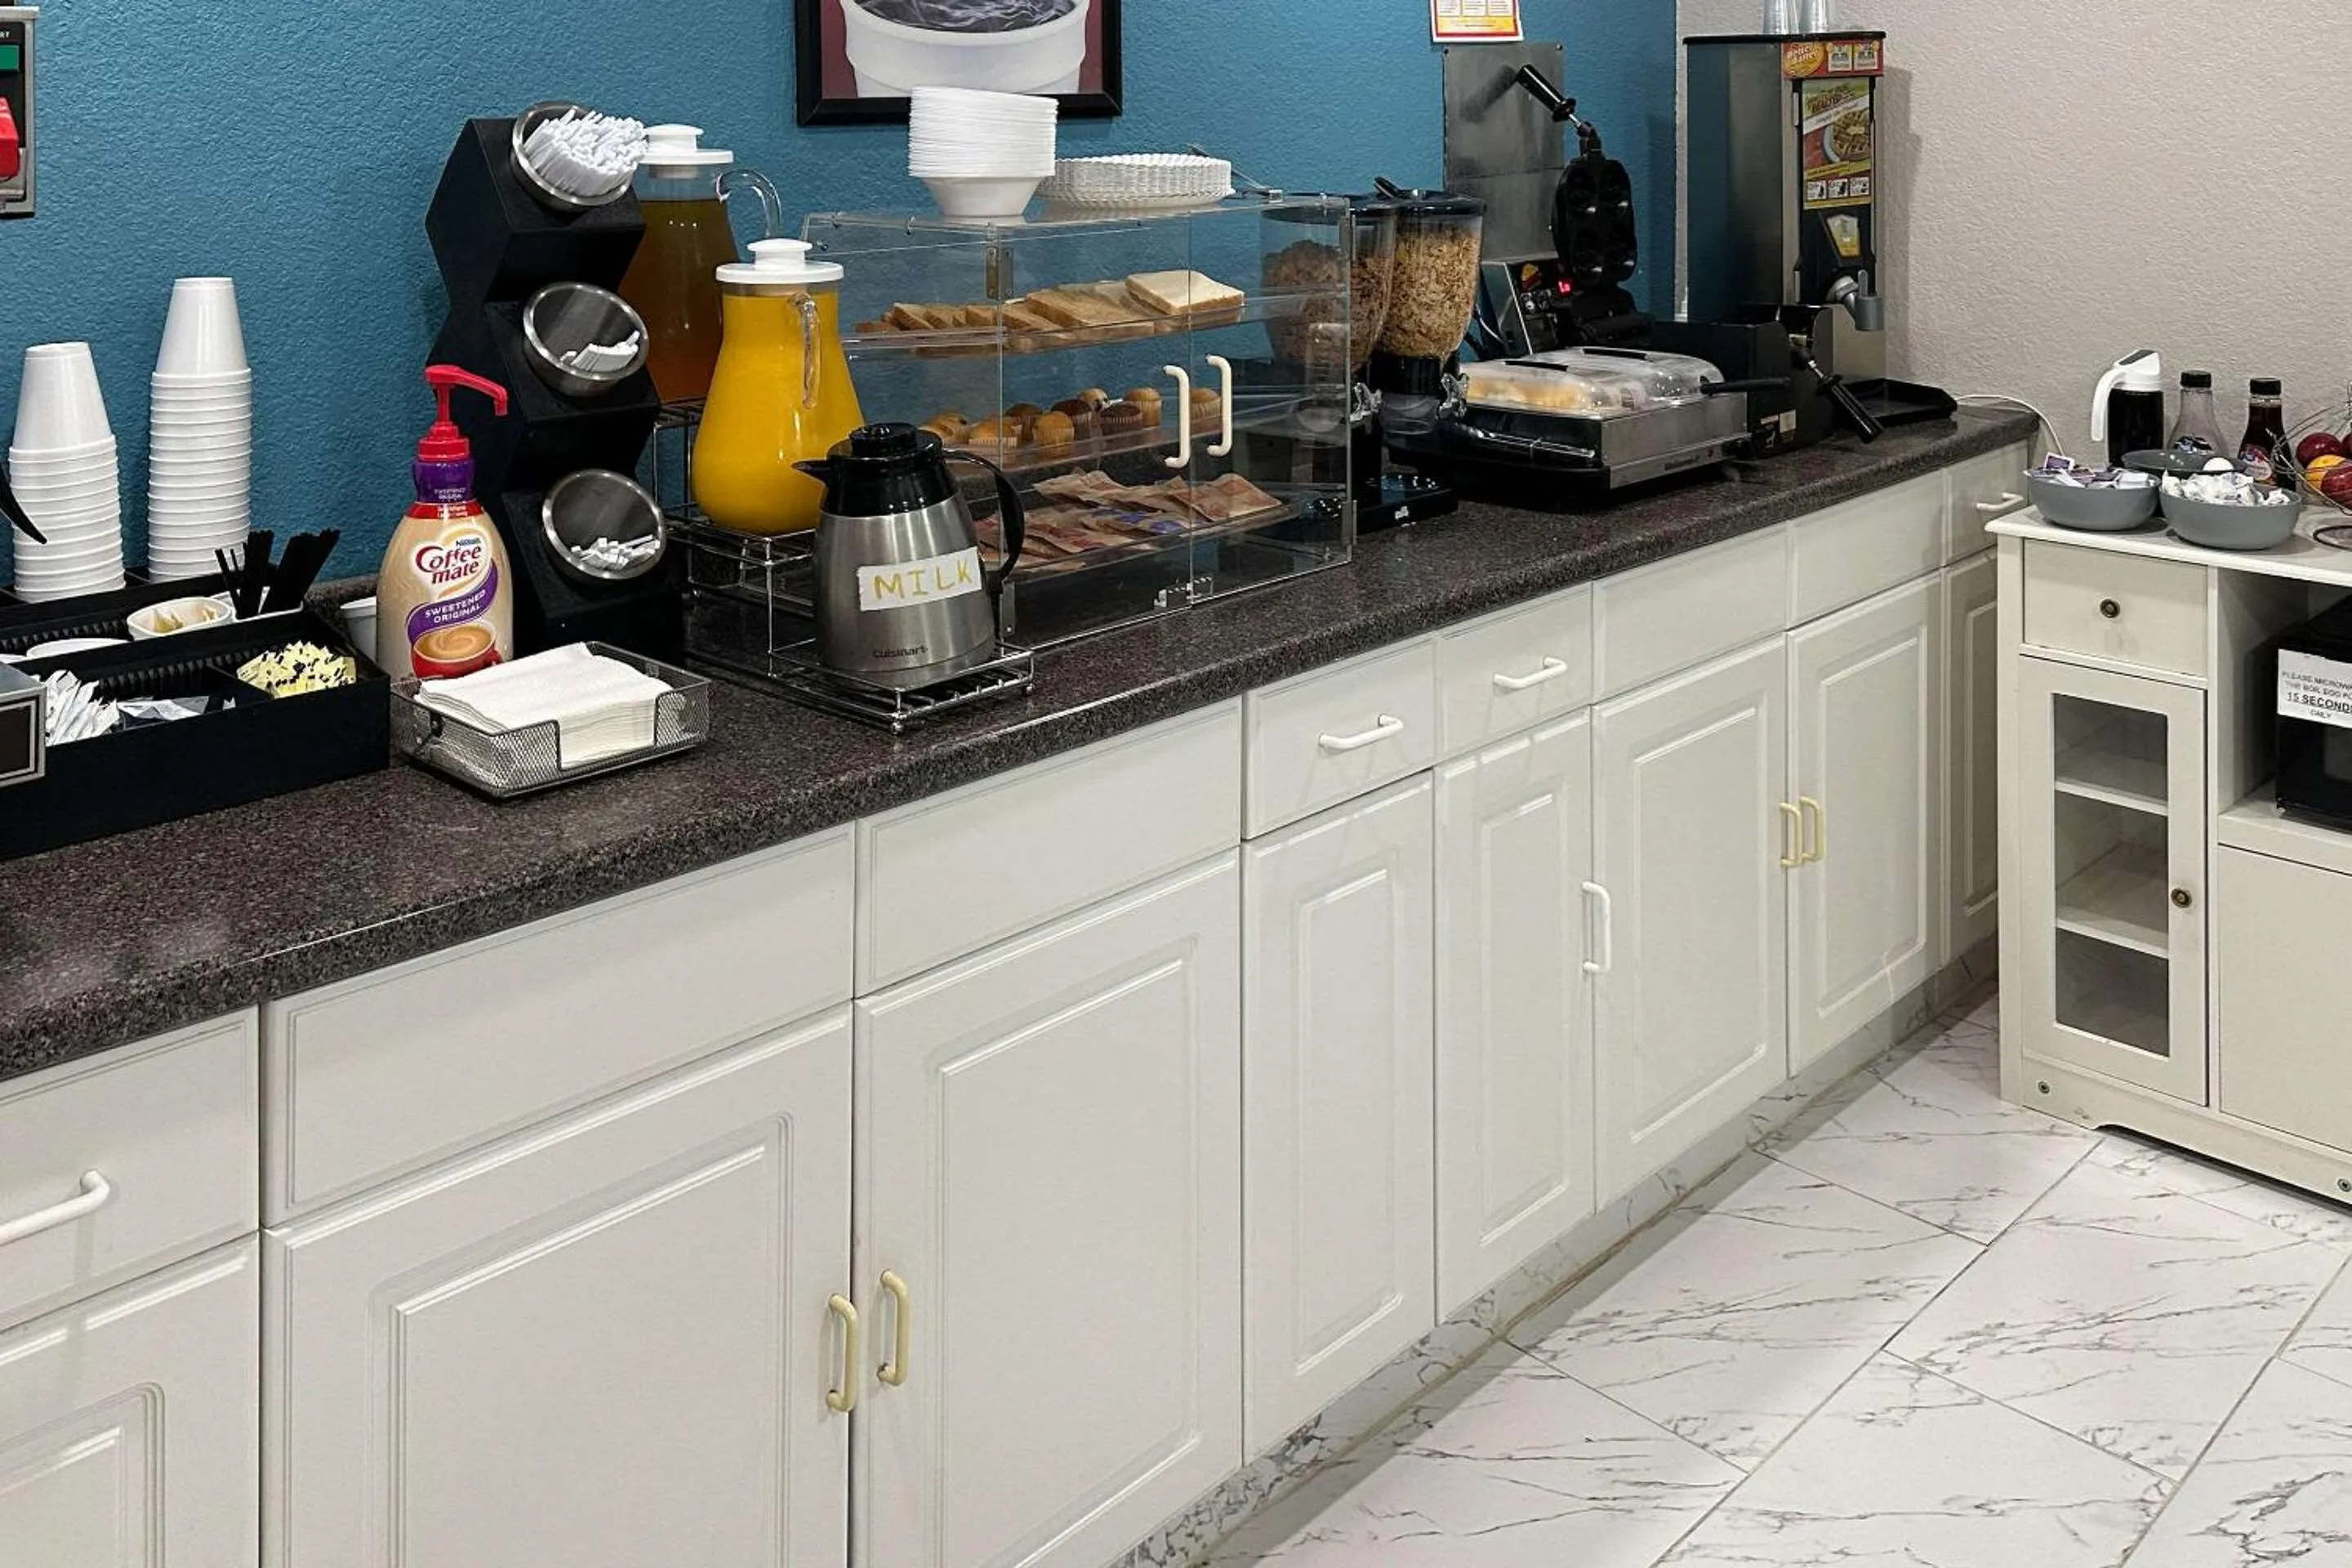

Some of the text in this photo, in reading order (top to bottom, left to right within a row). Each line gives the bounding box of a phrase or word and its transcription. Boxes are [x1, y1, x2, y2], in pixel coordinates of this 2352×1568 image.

[416, 546, 482, 572] Coffee
[431, 560, 479, 584] mate
[874, 559, 972, 599] MILK
[425, 589, 486, 618] SWEETENED
[434, 603, 481, 623] ORIGINAL
[874, 645, 929, 658] Cuisinart
[2282, 671, 2313, 683] PLEASE
[2287, 692, 2300, 703] 15
